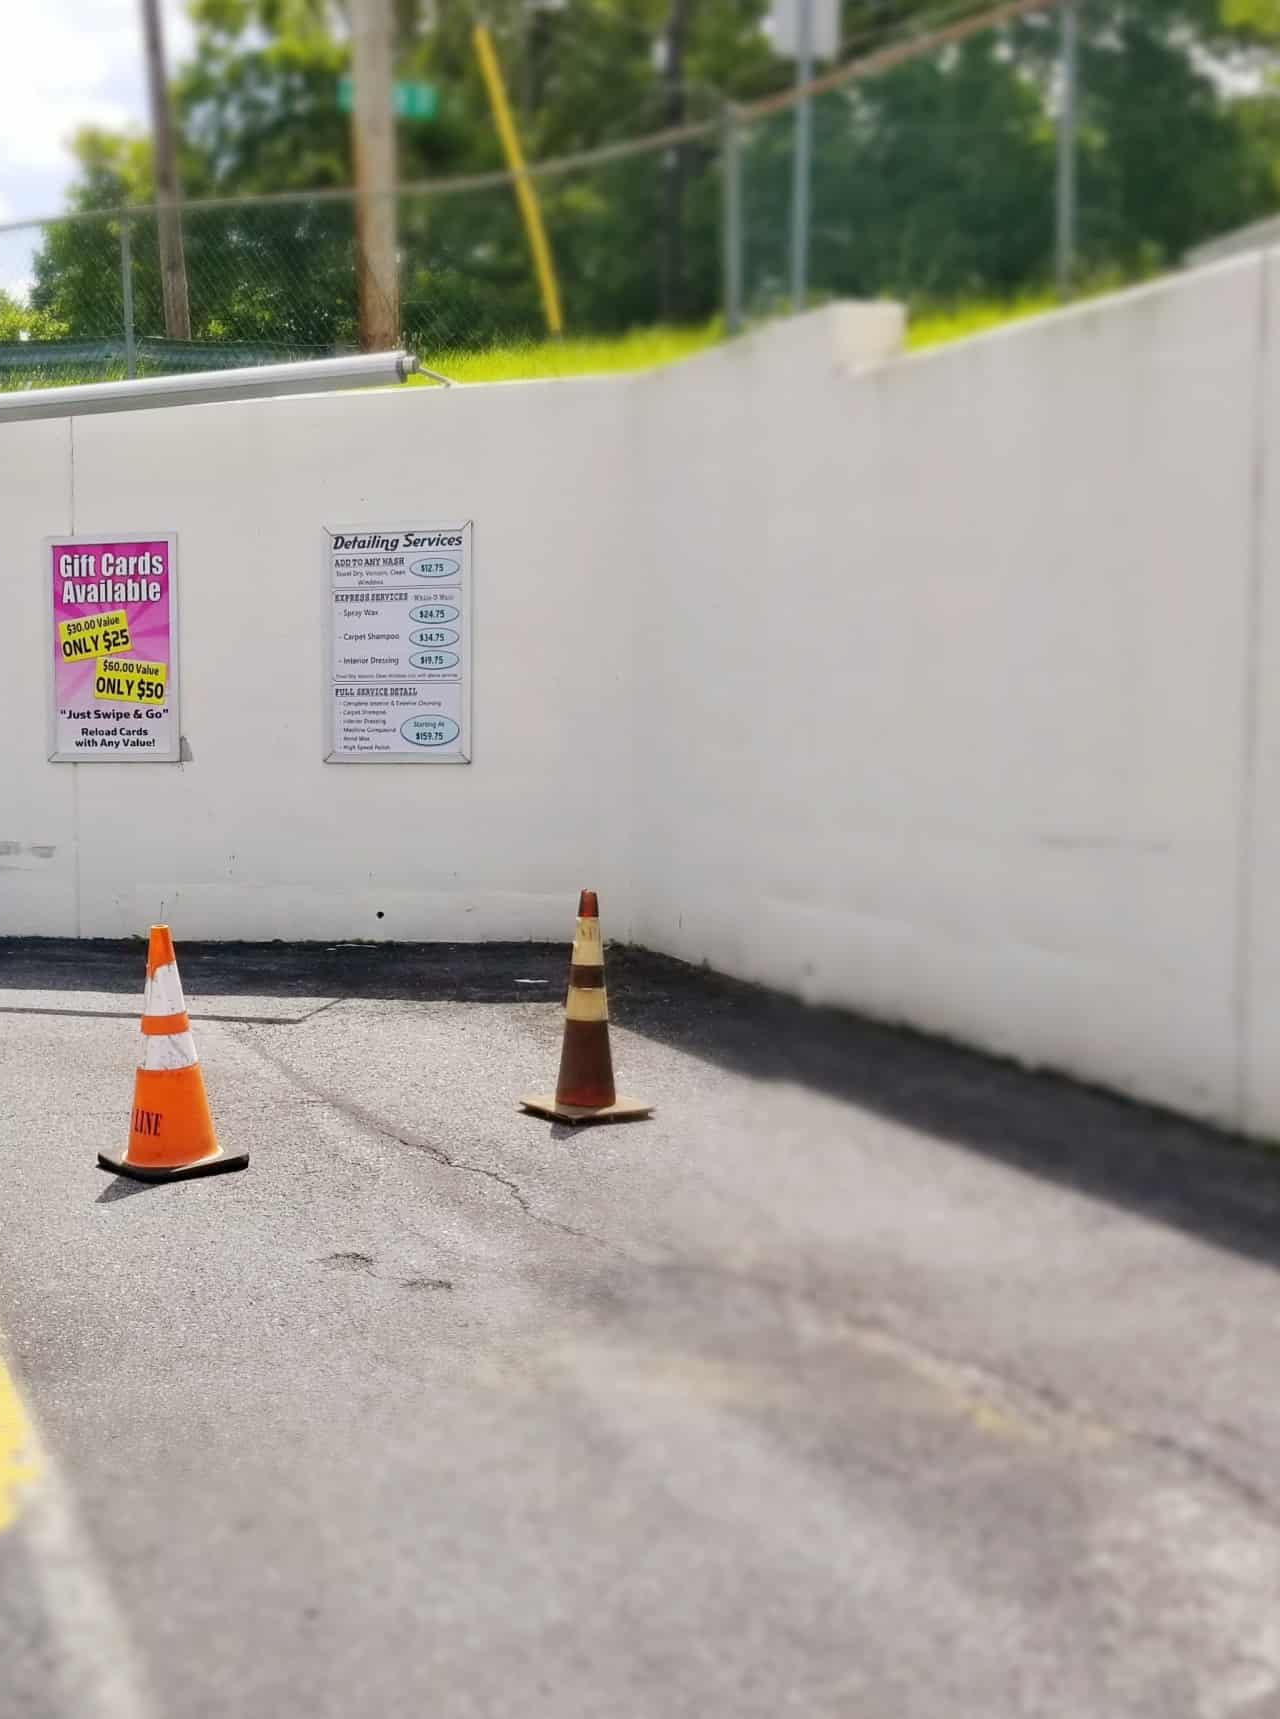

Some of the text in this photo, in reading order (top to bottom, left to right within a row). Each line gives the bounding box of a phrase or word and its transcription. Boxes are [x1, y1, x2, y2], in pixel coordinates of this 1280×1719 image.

[333, 533, 462, 551] Detailing Services
[59, 552, 164, 577] Gift Cards
[335, 559, 351, 567] ADD
[364, 559, 381, 567] ANY
[382, 557, 404, 566] WASH
[421, 564, 444, 572] $12.75
[63, 579, 161, 604] Available
[335, 593, 370, 602] EXPRESS
[371, 592, 408, 601] SERVICES
[344, 609, 362, 618] Spray
[419, 609, 445, 618] $24.75
[67, 616, 120, 635] $30.00 Value
[343, 632, 400, 642] Carpet Shampoo
[419, 632, 445, 642] $34.75
[63, 628, 130, 658] ONLY $25
[343, 656, 399, 666] Interior Dressing
[420, 655, 444, 665] $19.75
[103, 660, 160, 676] $60.00 Value
[96, 676, 164, 700] ONLY $50
[335, 688, 417, 697] FULL SERVICE DETAIL
[60, 709, 91, 719] "Just
[94, 709, 131, 722] Swipe
[134, 710, 143, 719] &
[81, 728, 148, 736] Reload Cards
[416, 732, 443, 740] $159.75
[75, 738, 155, 748] with Any Value!
[134, 1108, 162, 1136] LINE
